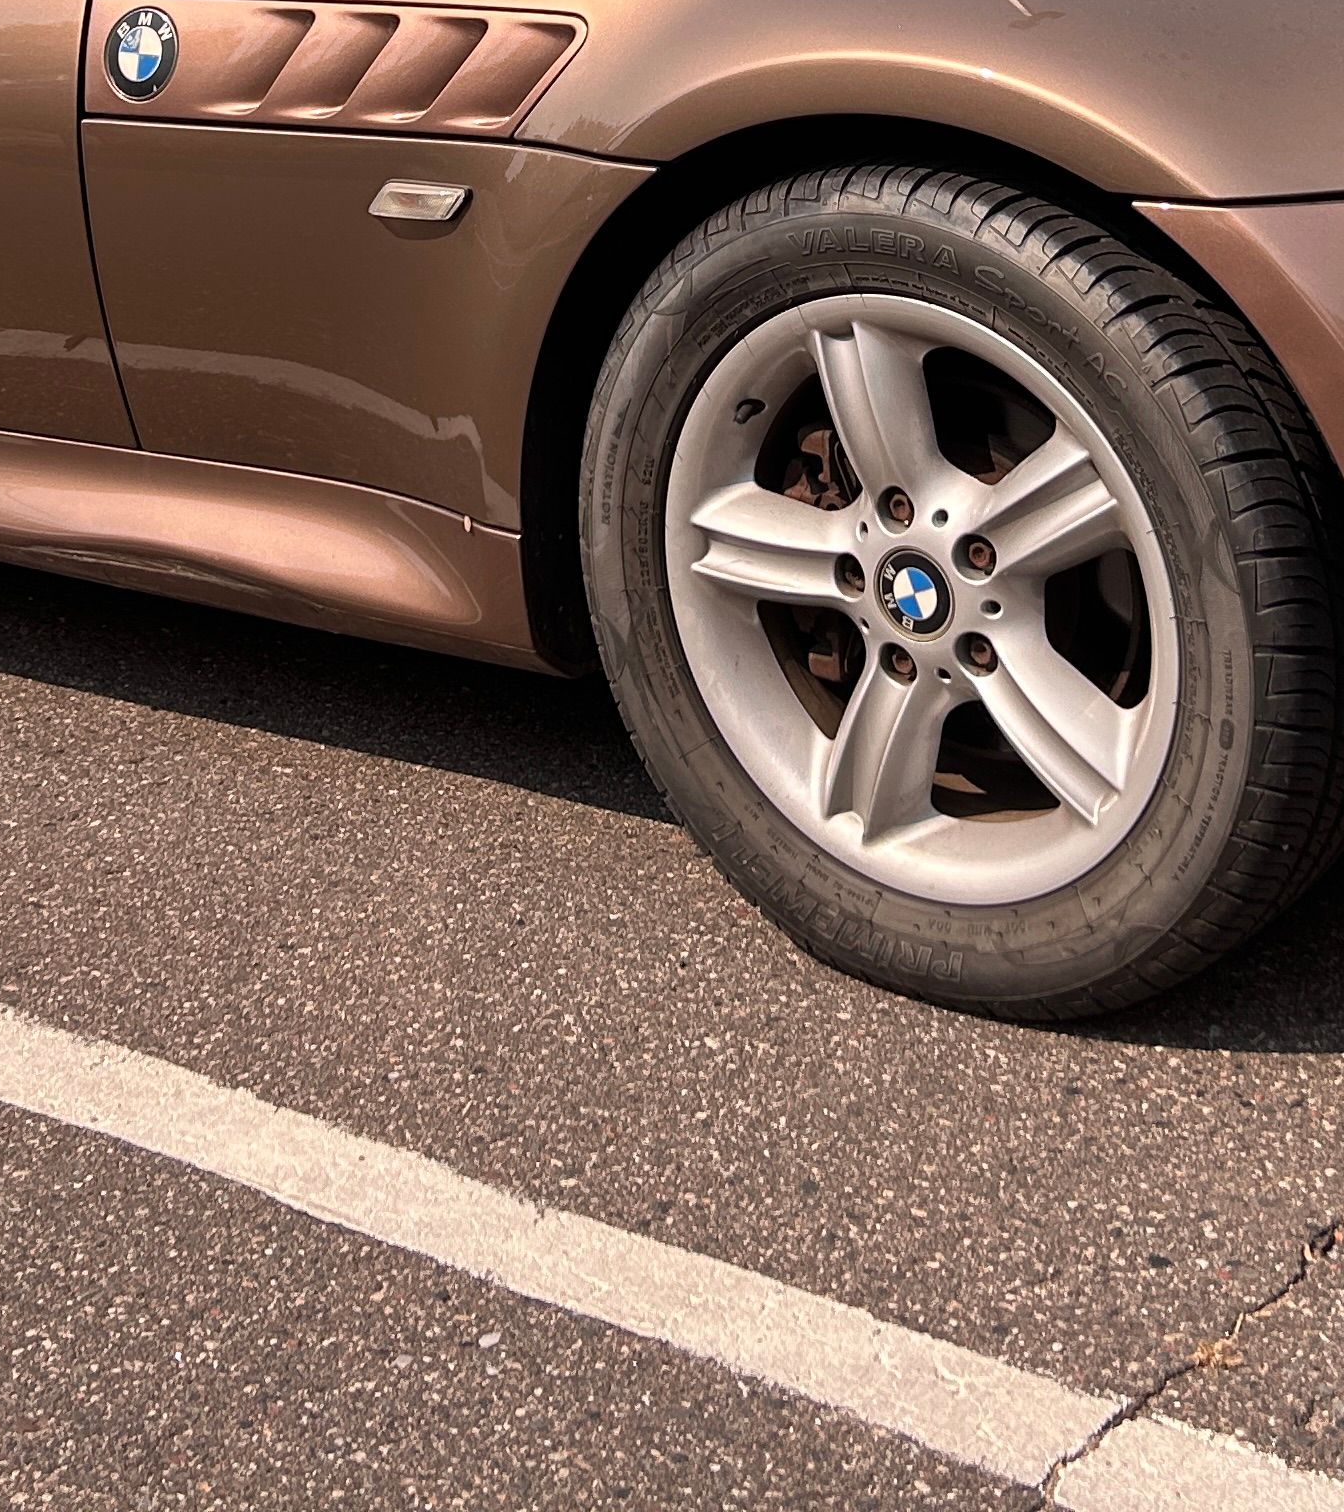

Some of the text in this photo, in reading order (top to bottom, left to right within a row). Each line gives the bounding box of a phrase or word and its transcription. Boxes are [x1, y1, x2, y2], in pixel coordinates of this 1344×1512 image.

[117, 12, 173, 41] BMW
[787, 226, 960, 276] VALERA
[974, 265, 1081, 350] Sport
[601, 443, 619, 526] ROTATION
[884, 563, 914, 631] BMW
[712, 823, 963, 982] PRIMEWELL
